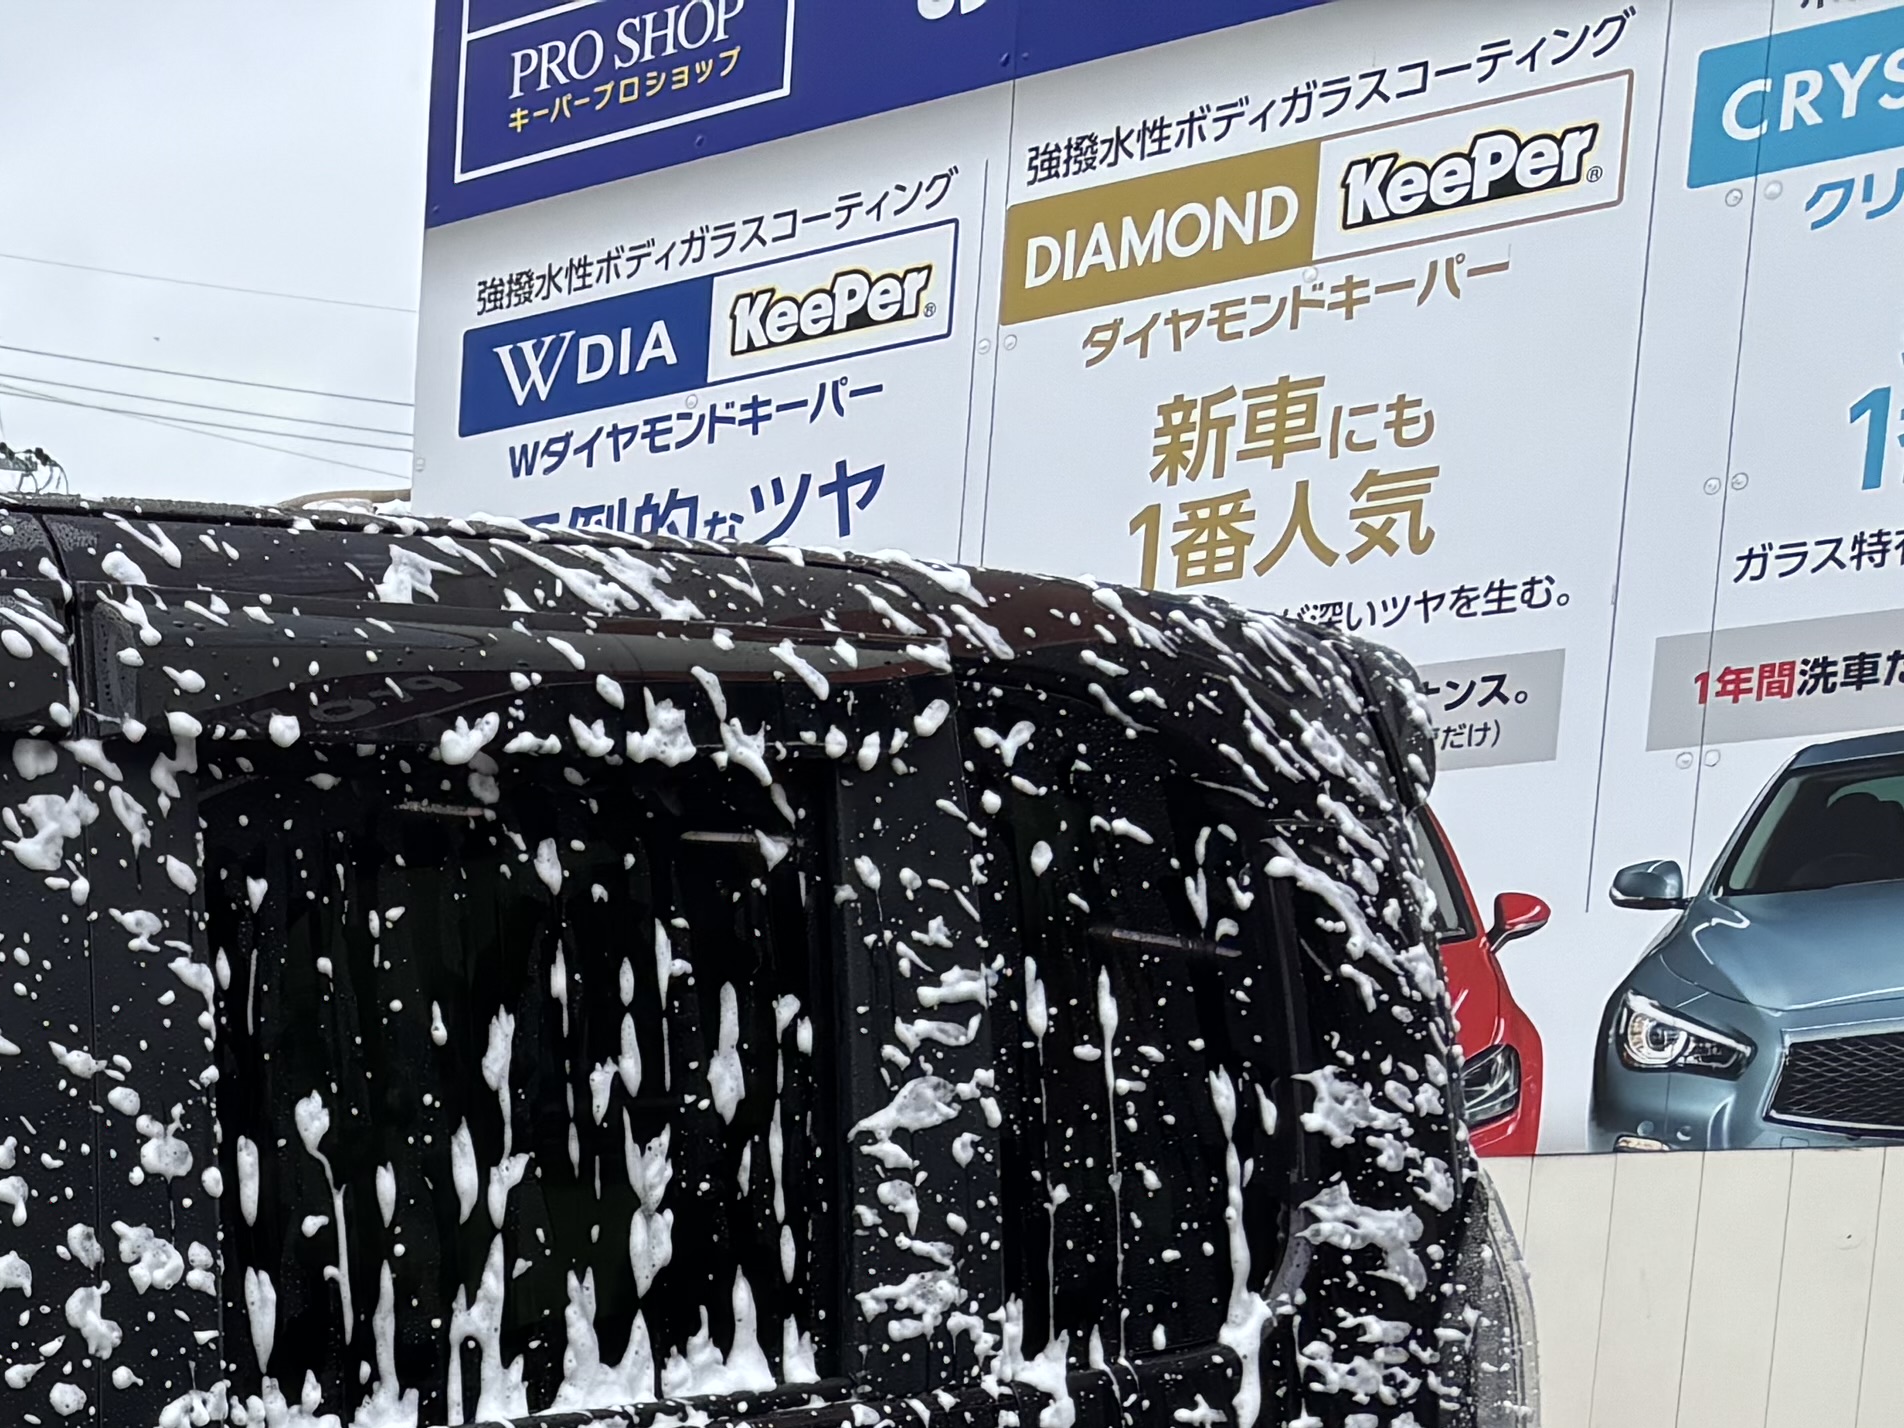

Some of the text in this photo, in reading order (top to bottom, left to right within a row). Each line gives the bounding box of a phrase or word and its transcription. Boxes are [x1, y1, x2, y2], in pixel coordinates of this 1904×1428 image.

[508, 0, 744, 100] PRO SHOP
[508, 45, 742, 133] キーパープロショップ
[1025, 5, 1638, 187] 強撥水性ボディガラスコーティング
[476, 165, 960, 316] 強撥水性ボディガラスコーティング
[1024, 184, 1300, 289] DIAMOND
[1081, 252, 1512, 368] ダイヤモンドキーパー
[508, 375, 884, 479] Wダイヤモンドキーパー
[1149, 375, 1436, 487] 新車にも
[1128, 465, 1441, 591] 1番人気
[1733, 529, 1904, 584] ガラス特
[1282, 575, 1571, 631] 深いツヤを生む。
